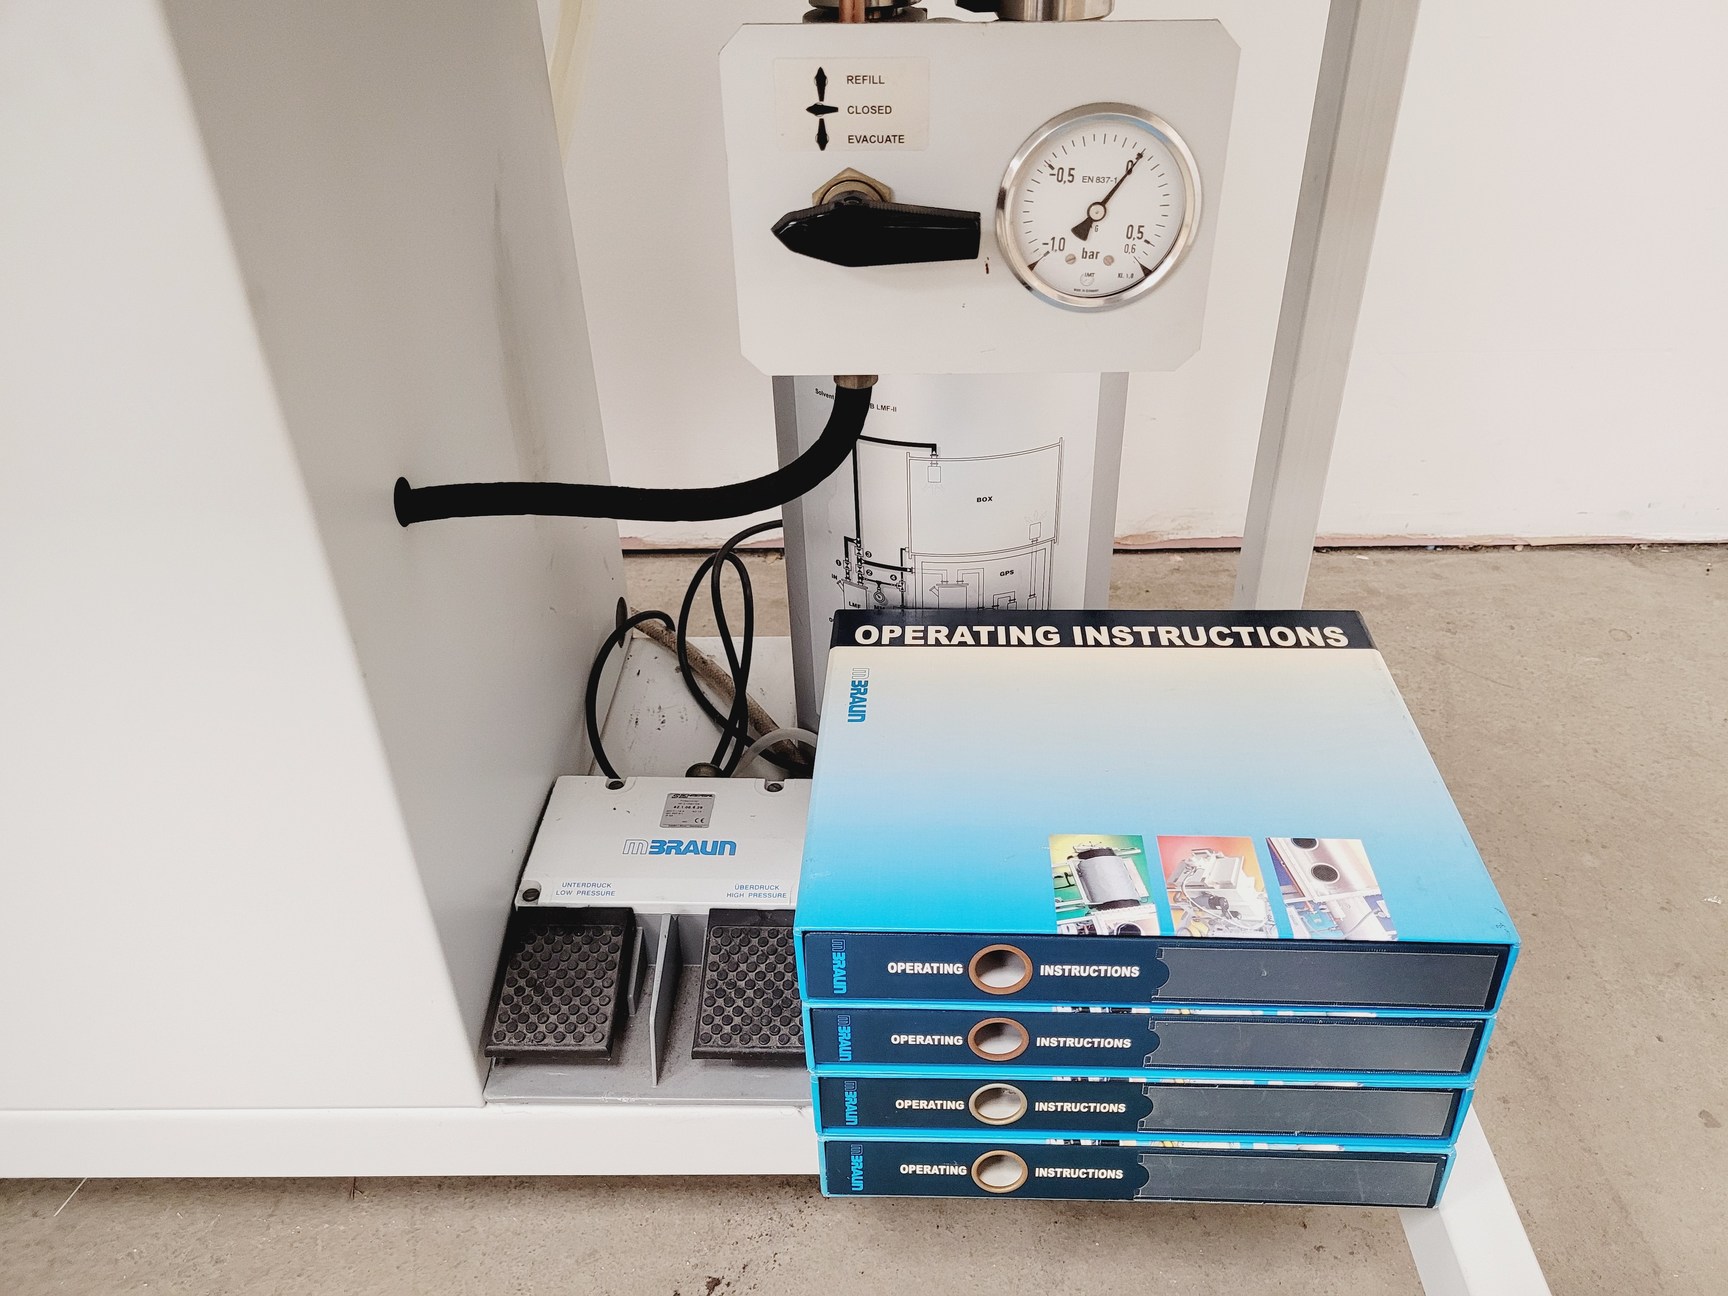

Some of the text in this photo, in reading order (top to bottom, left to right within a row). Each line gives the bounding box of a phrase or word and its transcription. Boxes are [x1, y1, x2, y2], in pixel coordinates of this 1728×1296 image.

[846, 75, 885, 85] REFILL
[847, 105, 892, 115] CLOSED
[847, 134, 905, 144] EVACUATE
[1081, 176, 1118, 184] EN 837-1
[1126, 224, 1145, 241] 0,5
[1081, 247, 1100, 260] bar
[1123, 243, 1137, 254] 0,6
[876, 403, 897, 412] LMF-II
[976, 495, 993, 503] BOX
[999, 569, 1015, 577] GPS
[854, 625, 1349, 647] OPERATING INSTRUCTIONS
[561, 881, 612, 889] UNTERDRUCK
[734, 883, 780, 891] ÜBERDRUCK
[555, 889, 616, 897] LOW PRESSURE
[887, 961, 1140, 978] OPERATING INSTRUCTIONS
[890, 1034, 1132, 1049] OPERATING INSTRUCTIONS
[895, 1099, 1126, 1113] OPERATING INSTRUCTIONS
[899, 1164, 1124, 1180] OPERATING INSTRUCTIONS
